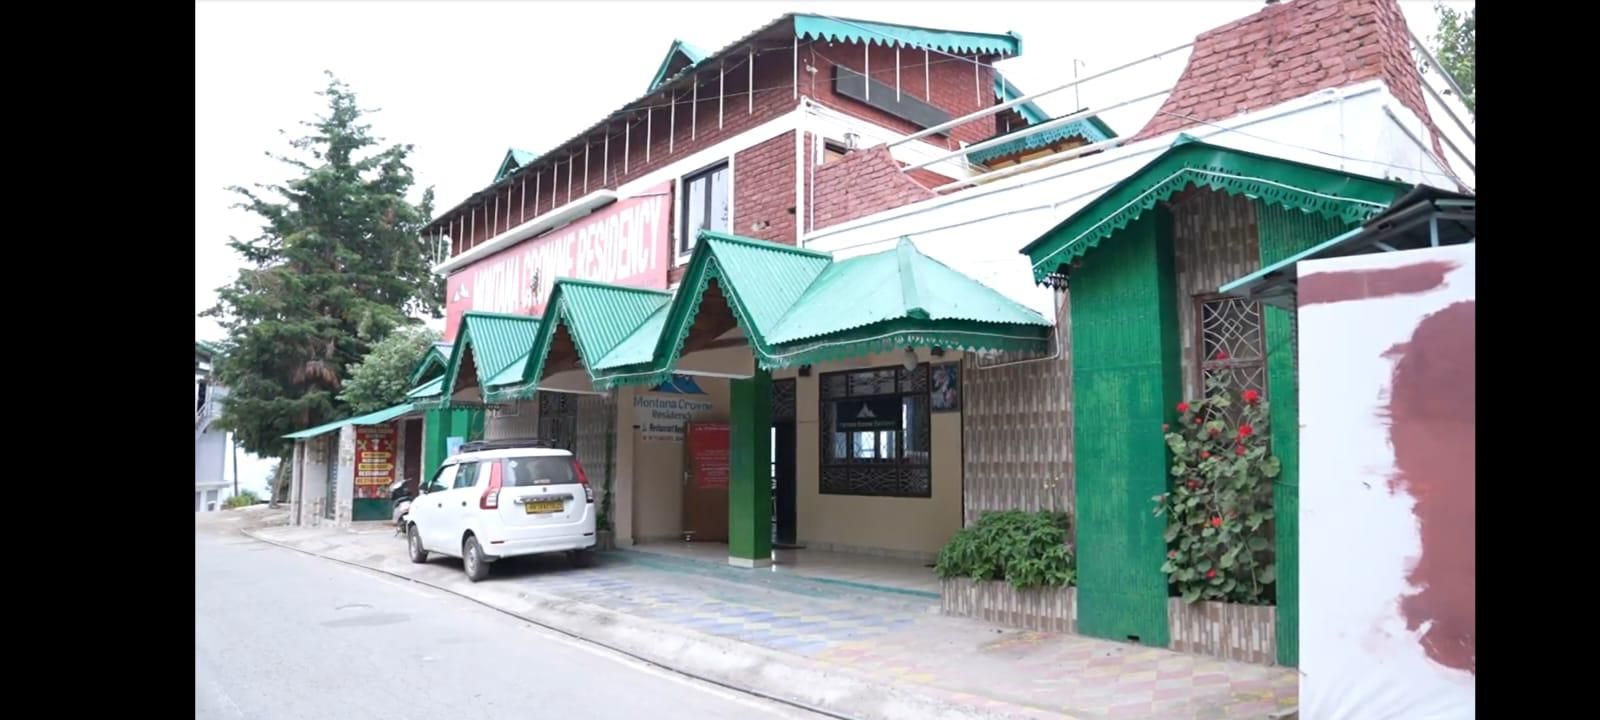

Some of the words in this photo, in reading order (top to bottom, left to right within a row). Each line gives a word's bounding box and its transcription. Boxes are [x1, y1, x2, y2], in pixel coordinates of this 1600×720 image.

[472, 256, 519, 313] MONTANA
[576, 196, 660, 282] RESIDENCY
[633, 396, 676, 409] Montana
